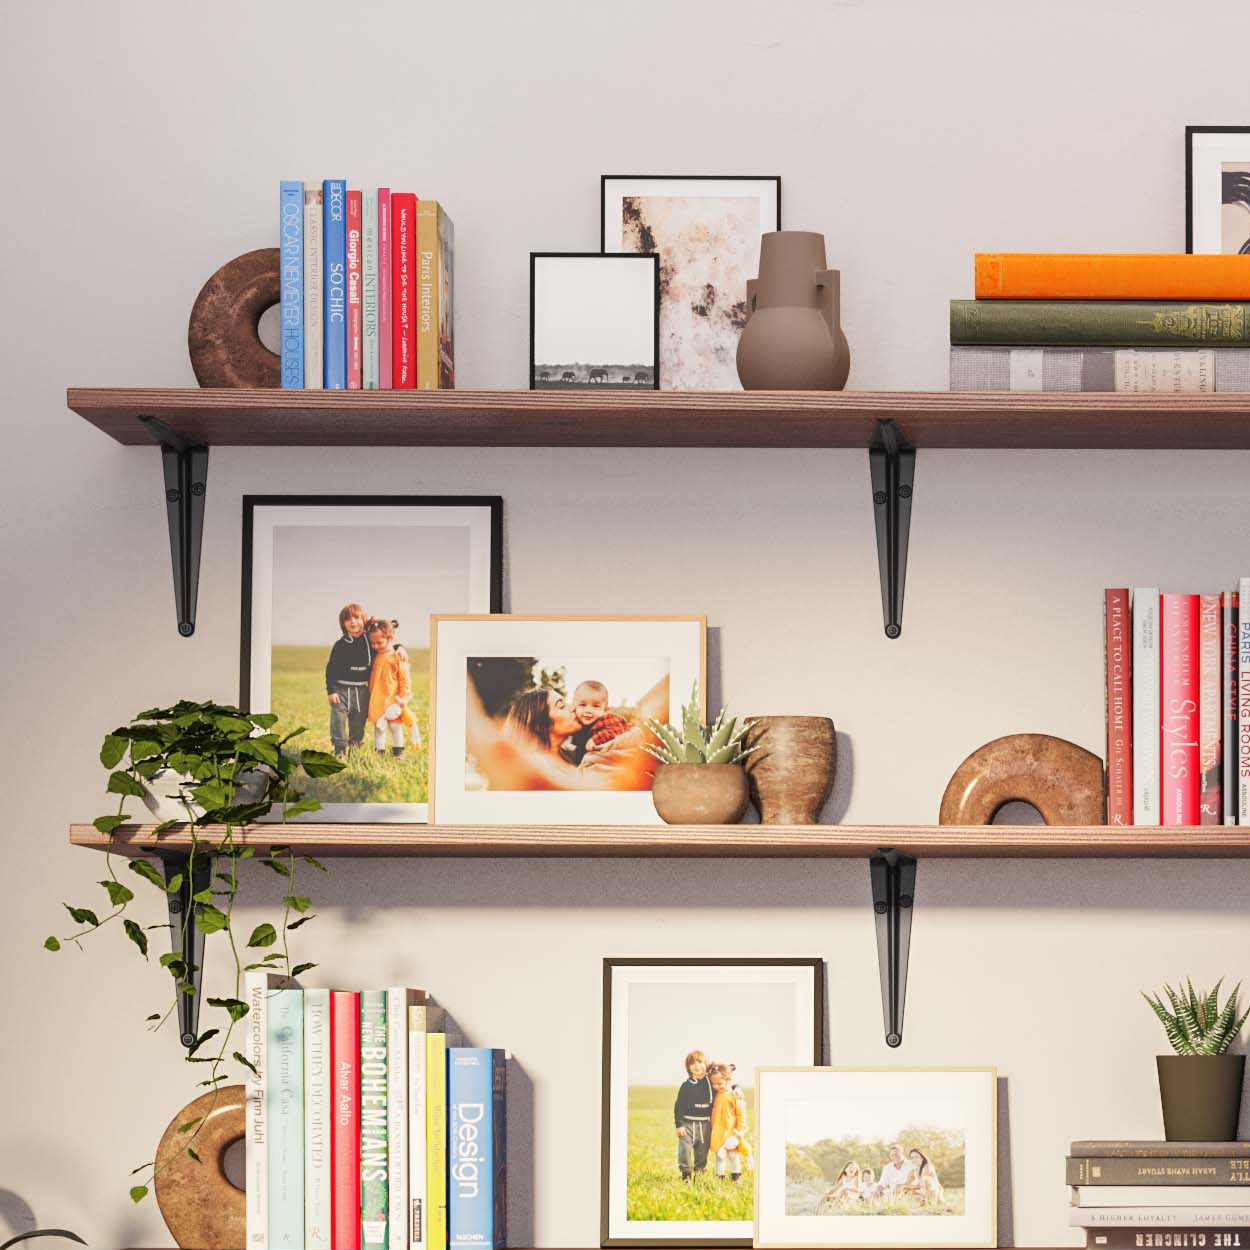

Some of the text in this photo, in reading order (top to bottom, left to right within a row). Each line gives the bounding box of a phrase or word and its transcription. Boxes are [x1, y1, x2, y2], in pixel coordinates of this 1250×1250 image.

[347, 230, 359, 270] Giorgio
[366, 227, 374, 271] mexican
[283, 203, 300, 385] OSCAR NIEMEYER HOUSES
[330, 263, 343, 323] SO CHIC
[349, 272, 359, 304] Casali
[365, 273, 376, 337] INTERIORS
[421, 252, 433, 333] Paris Interiors
[1199, 351, 1208, 392] INKLING
[1113, 596, 1123, 733] A PLACE TO CALL HOME
[1241, 622, 1250, 664] PARIS
[1202, 604, 1217, 767] NEW YORK APARTMENTS
[1241, 671, 1250, 718] LIVING
[1161, 698, 1198, 779] Styles
[1241, 724, 1250, 778] ROOMS
[251, 987, 264, 1067] Watercolors
[311, 1003, 323, 1035] HOW
[362, 1022, 373, 1043] NEW
[374, 1024, 386, 1043] THE
[311, 1039, 323, 1077] THEY
[253, 1089, 264, 1116] Finn
[280, 1088, 295, 1115] Casa
[340, 1061, 352, 1126] Alvar Aalto
[361, 1047, 387, 1182] BOHEMIANS
[254, 1118, 265, 1145] Juhl
[311, 1082, 323, 1169] DECORATED
[452, 1103, 486, 1198] Design
[1137, 1167, 1166, 1176] STUART
[1191, 1167, 1217, 1175] SARAH
[1135, 1233, 1241, 1247] THE CLINCHER
